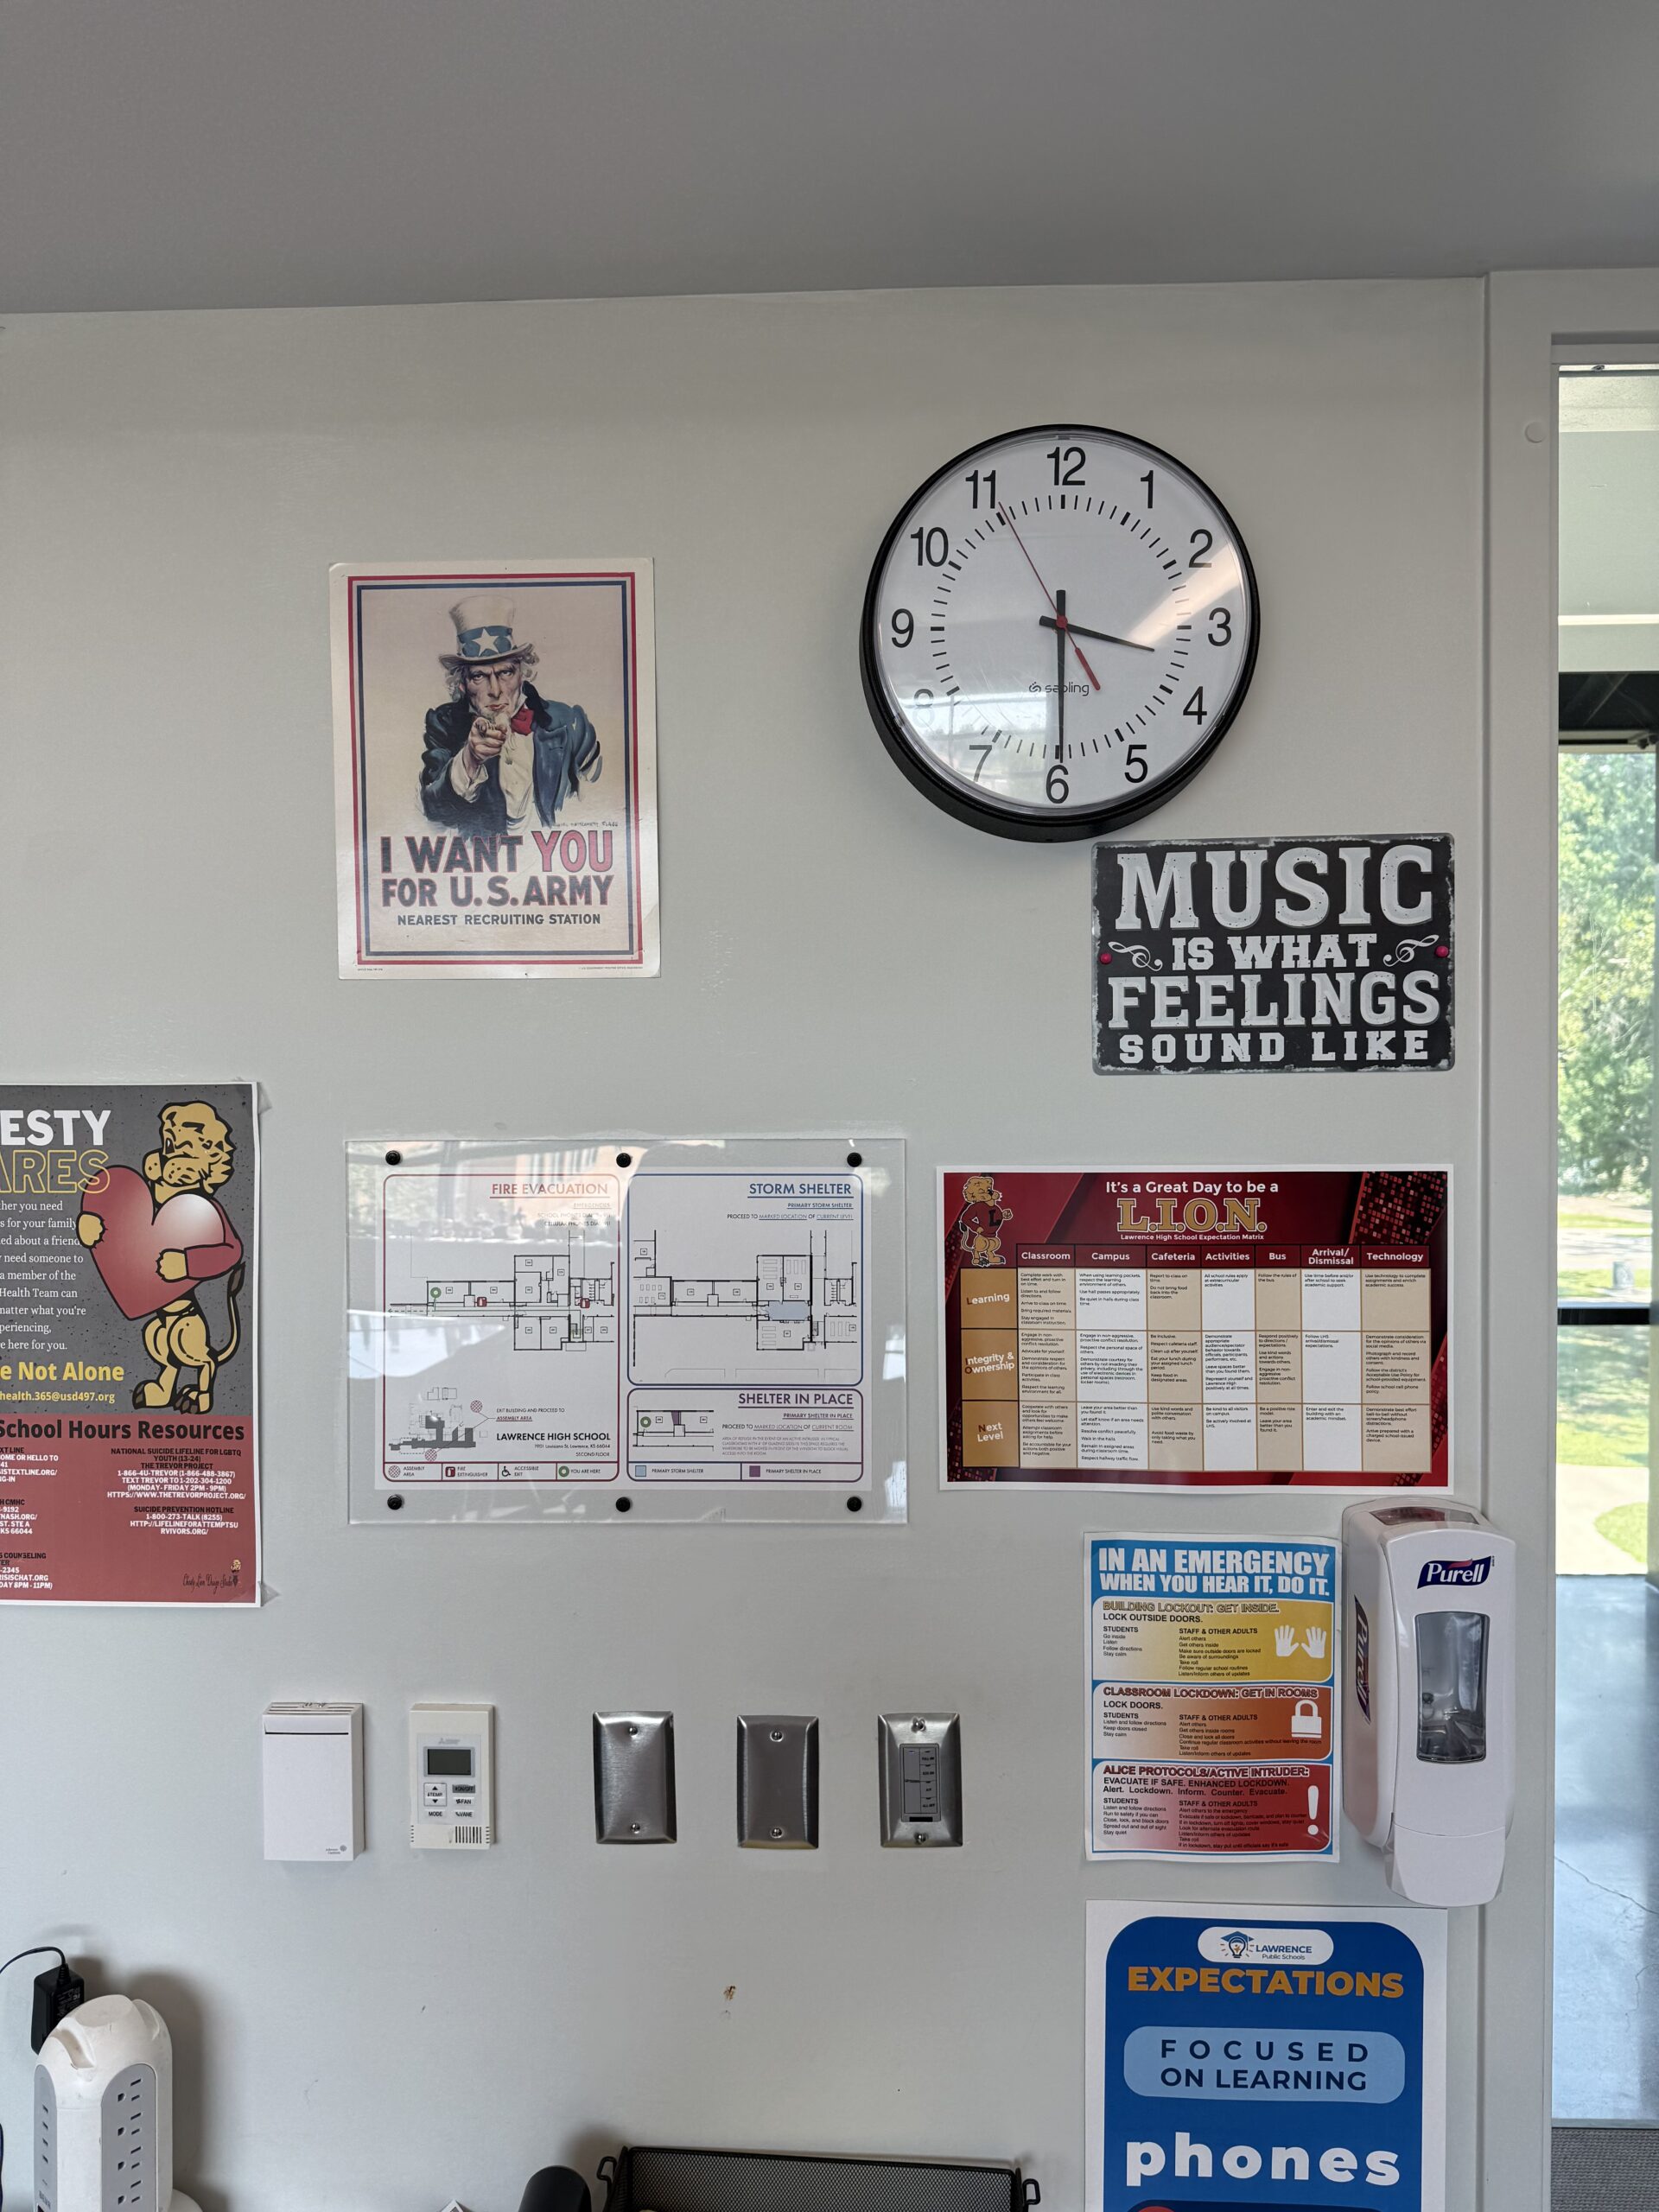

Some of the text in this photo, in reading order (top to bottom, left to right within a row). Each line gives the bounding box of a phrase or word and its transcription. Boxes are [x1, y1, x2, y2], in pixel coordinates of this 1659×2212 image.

[1047, 447, 1086, 486] 12
[966, 470, 996, 509] 11
[1141, 470, 1154, 509] 1
[911, 527, 950, 567] 10
[1189, 529, 1213, 568] 2
[892, 608, 914, 648] 9
[1208, 607, 1231, 646] 3
[1043, 682, 1090, 696] sapling
[1183, 686, 1207, 725] 4
[966, 745, 993, 782] 7
[1125, 745, 1147, 784] 5
[1046, 765, 1069, 804] 6
[380, 830, 613, 874] I WANT YOU
[383, 878, 437, 907] FOR
[1116, 844, 1432, 930] MUSIC
[397, 914, 601, 925] NEAREST RECRUITING STATION
[1173, 934, 1377, 970] IS WHAT
[1108, 970, 1440, 1028] FEELINGS
[1120, 1030, 1428, 1064] SOUND LIKE
[493, 1184, 607, 1194] FIRE EVACUATION
[750, 1184, 851, 1194] STORM SHELTER
[1106, 1182, 1128, 1192] It's
[1146, 1182, 1188, 1192] Great
[1193, 1182, 1222, 1196] Day
[1226, 1182, 1243, 1192] to
[1248, 1180, 1266, 1192] be
[1270, 1184, 1278, 1192] a
[19, 1200, 63, 1213] you need
[1117, 1198, 1268, 1233] L.I.O.N.
[8, 1217, 76, 1230] for your family
[15, 1235, 41, 1245] about
[4, 1253, 27, 1262] need
[1092, 1253, 1130, 1262] Campus
[1308, 1255, 1354, 1265] Dismissal
[1312, 1248, 1350, 1256] Arrival/
[1367, 1253, 1423, 1262] Technology
[8, 1270, 76, 1281] member of the
[0, 1287, 30, 1298] Health
[33, 1288, 59, 1298] Team
[967, 1294, 1010, 1305] Learning
[31, 1305, 54, 1318] what
[56, 1306, 86, 1318] you're
[8, 1339, 67, 1352] here for you.
[965, 1361, 1015, 1375] Ownership
[966, 1351, 1014, 1366] Integrity &
[19, 1362, 124, 1381] Not Alone
[739, 1393, 853, 1405] SHELTER IN PLACE
[0, 1419, 245, 1440] School Hours Resources
[977, 1431, 1003, 1442] Level
[979, 1422, 1003, 1433] Next
[1099, 1548, 1329, 1576] IN AN EMERGENCY
[1427, 1562, 1484, 1583] Purell
[1100, 1573, 1329, 1596] WHEN YOU HEAR IT, DO IT.
[1103, 1600, 1280, 1614] BUILDING LOCKOUT: GET INSIDE.
[1357, 1614, 1368, 1706] Purell
[1103, 1687, 1319, 1699] CLASSROOM LOCKDOWN: GET IN ROOMS
[1103, 1765, 1309, 1777] ALICE PROTOCOLS/ACTIVE INTRUDER:
[1256, 1945, 1313, 1954] LAWRENCE
[1128, 1967, 1404, 1998] EXPECTATIONS
[1161, 2039, 1368, 2063] FOCUSED
[1161, 2068, 1366, 2091] ON LEARNING
[1127, 2133, 1400, 2187] phones
